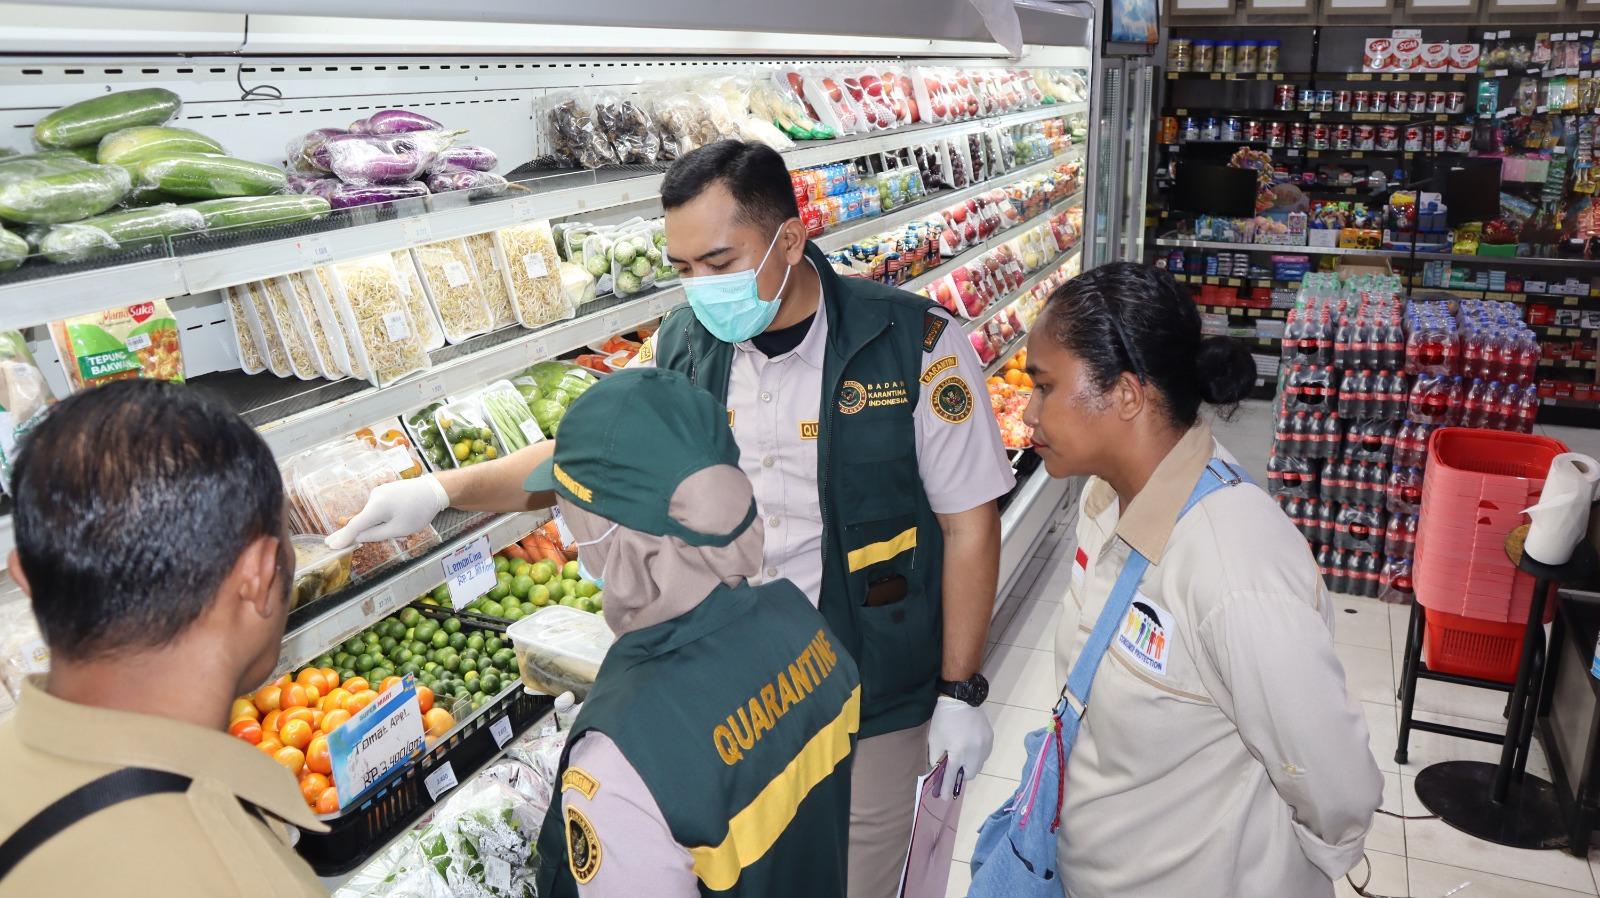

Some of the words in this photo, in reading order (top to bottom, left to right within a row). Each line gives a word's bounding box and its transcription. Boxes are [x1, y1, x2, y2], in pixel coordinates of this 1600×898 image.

[1371, 40, 1389, 51] SGM
[1399, 40, 1418, 51] SGM
[129, 304, 154, 317] Suka
[87, 351, 126, 366] TEPUNG
[868, 389, 907, 399] KARANTINA
[868, 397, 909, 407] INDONESIA
[713, 629, 837, 766] QUARANTINE
